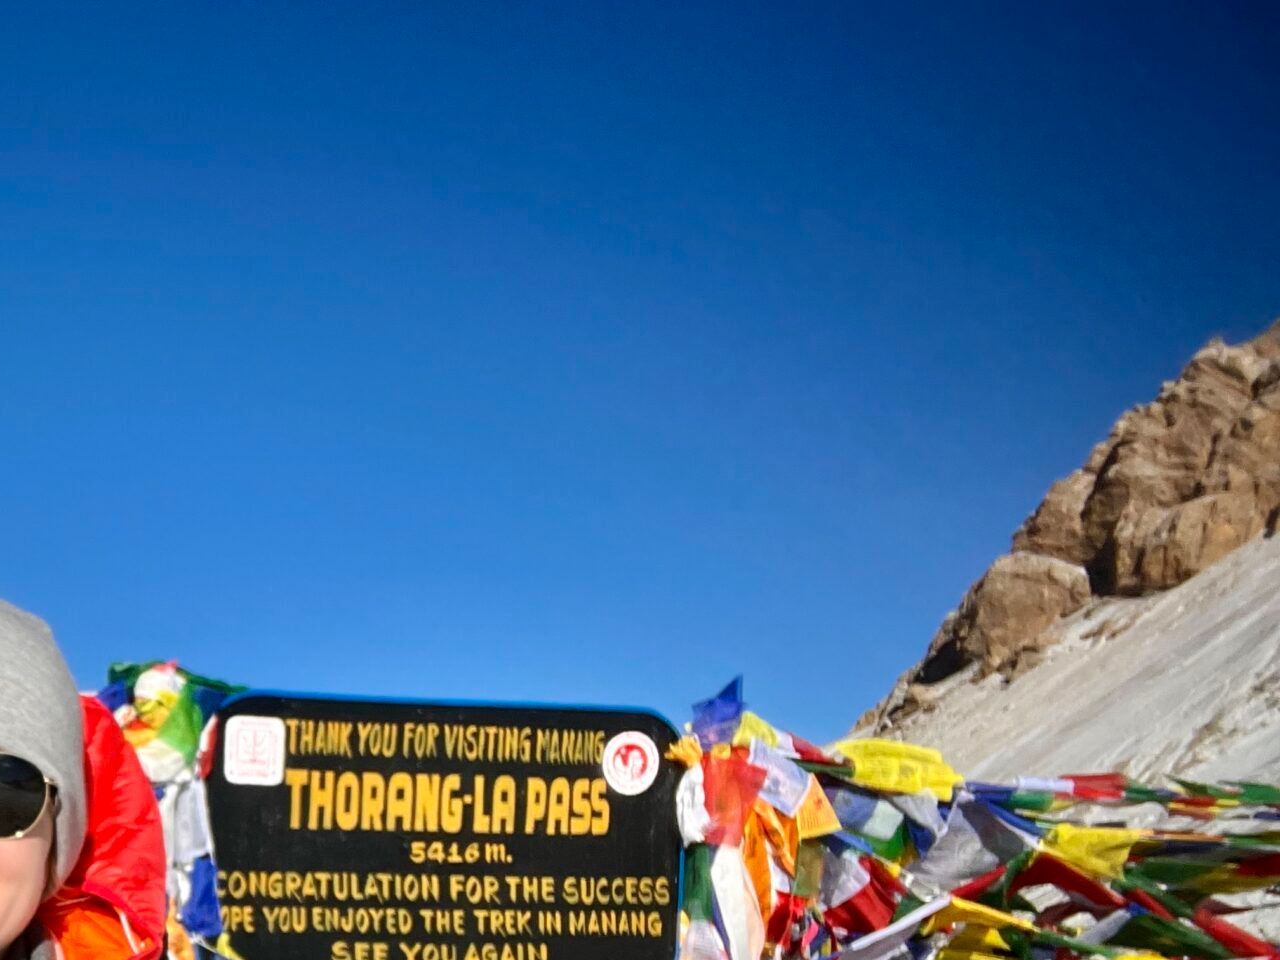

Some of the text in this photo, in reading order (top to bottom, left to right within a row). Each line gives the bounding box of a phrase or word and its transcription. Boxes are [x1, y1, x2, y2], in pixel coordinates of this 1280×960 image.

[286, 718, 605, 765] THANK YOU FOR VISITING MANANG
[285, 768, 610, 836] THORANG-LA PASS
[410, 840, 480, 864] 5416
[217, 870, 670, 906] CONGRATULATION FOR THE SUCCESS
[221, 904, 663, 938] OPE YOU ENJOYED THE TREK IN MANANG
